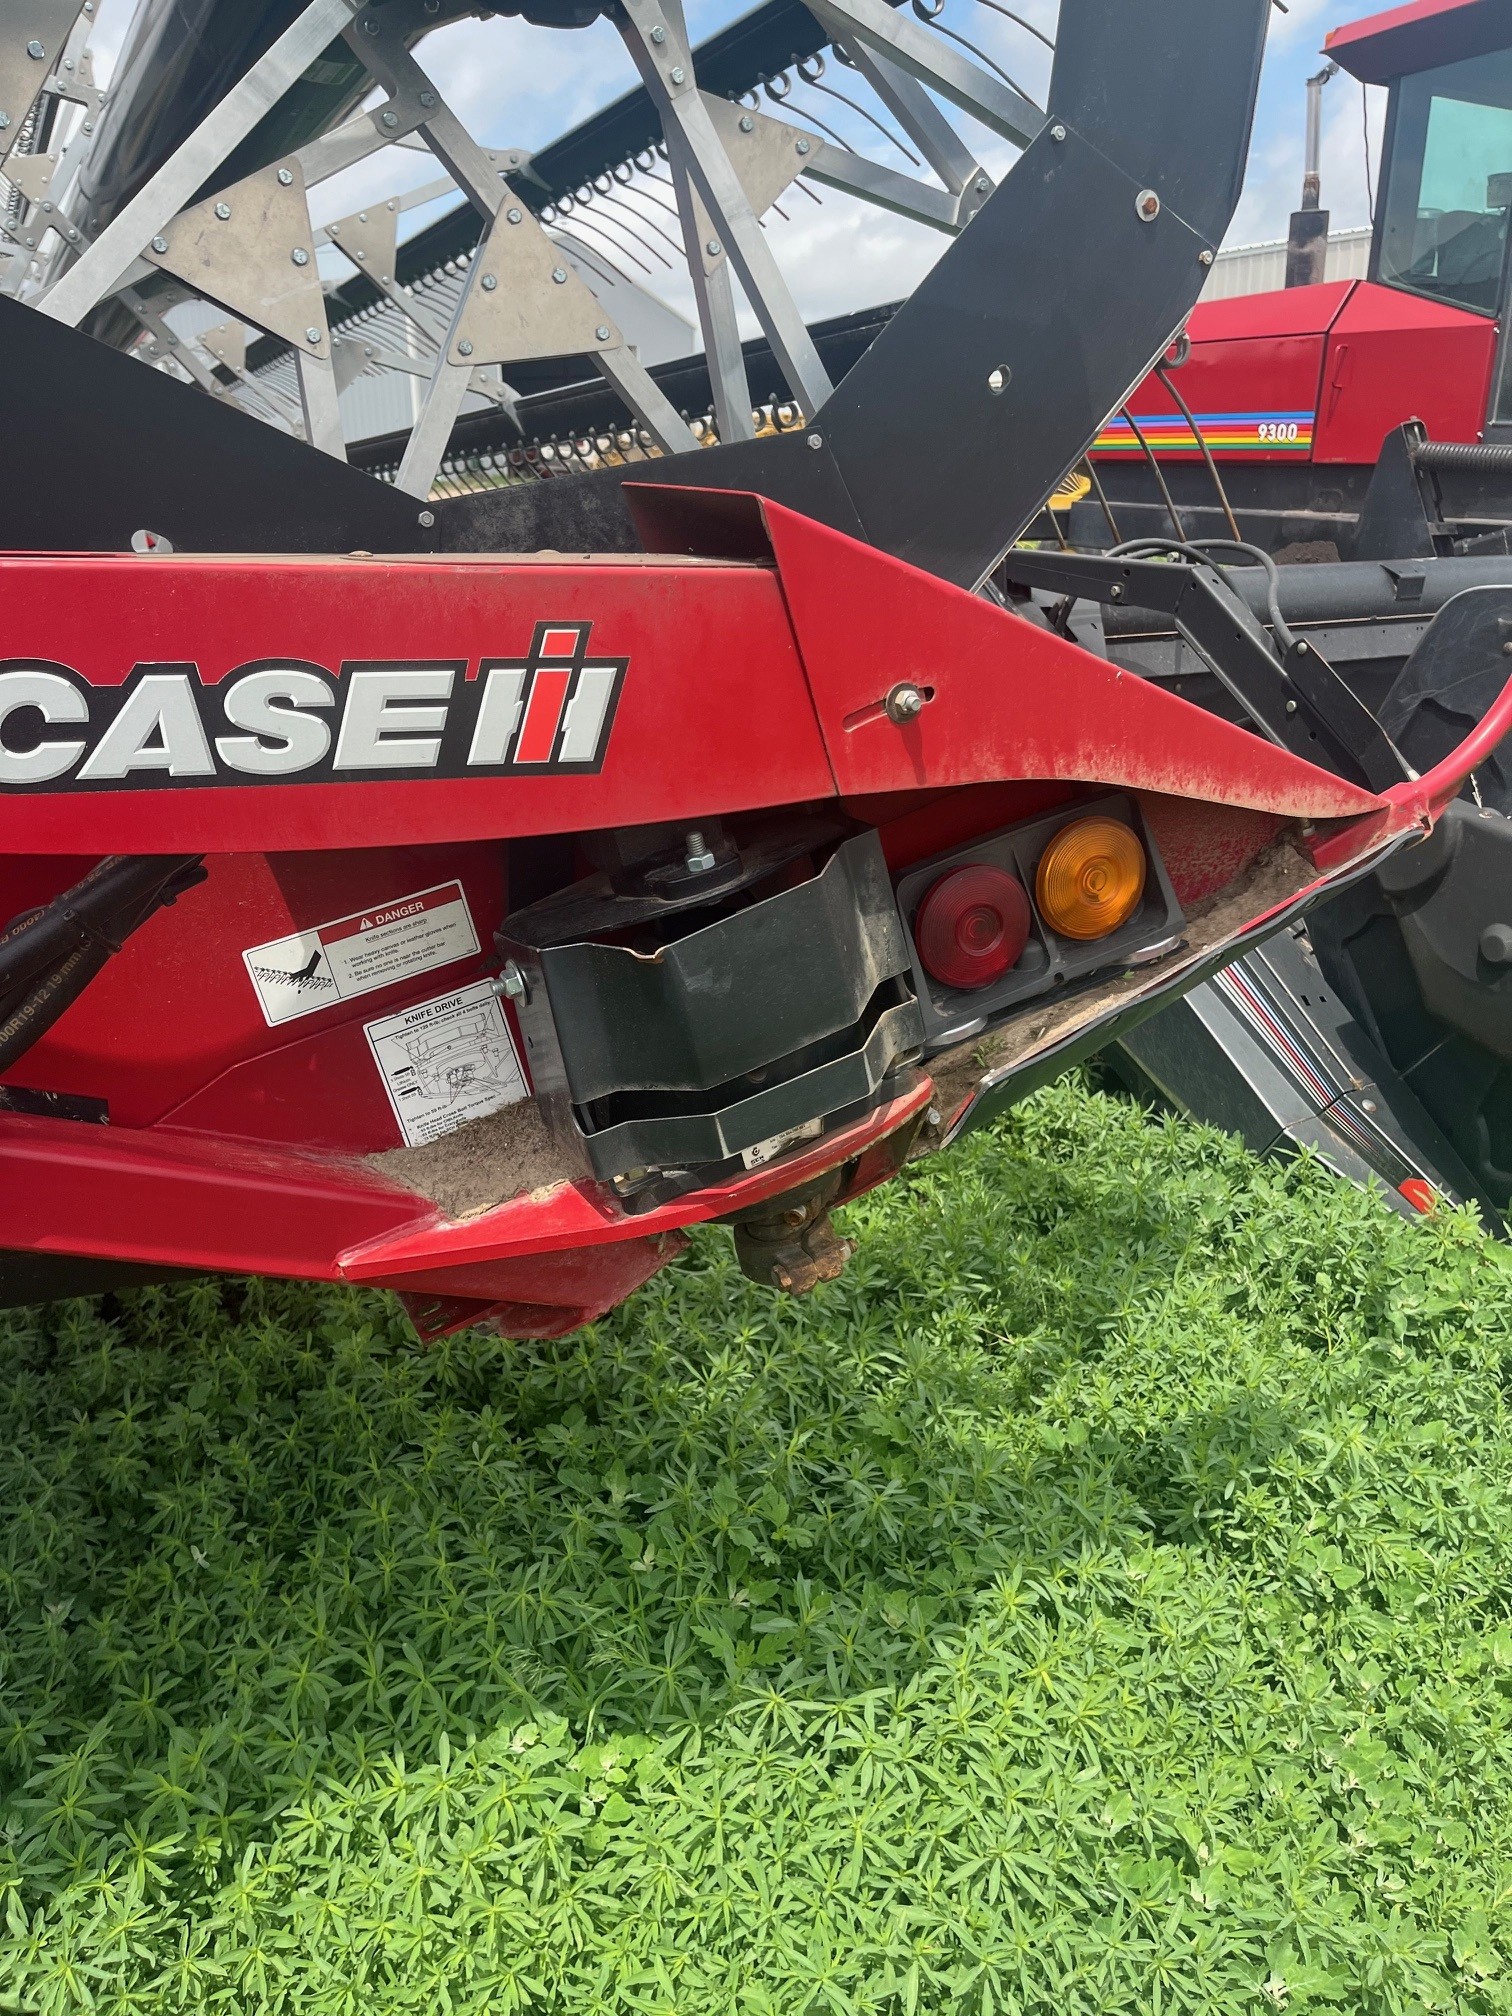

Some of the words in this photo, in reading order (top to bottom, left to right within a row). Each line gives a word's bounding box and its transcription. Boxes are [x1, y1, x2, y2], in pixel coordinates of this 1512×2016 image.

[1258, 423, 1298, 442] 9300
[0, 670, 455, 783] CASE
[375, 901, 424, 925] DANGER
[349, 953, 364, 962] Wear
[365, 950, 380, 959] heavy
[381, 943, 400, 952] canvas
[407, 934, 424, 943] leather
[425, 927, 442, 938] gloves
[443, 923, 457, 931] when
[365, 934, 379, 943] Knife
[380, 927, 403, 938] sections
[352, 958, 373, 968] working
[374, 954, 384, 962] with
[372, 966, 396, 977] removing
[403, 956, 423, 966] rotating
[400, 954, 411, 962] near
[0, 988, 51, 1046] 00R19-12
[49, 974, 63, 989] 19
[60, 951, 82, 977] mm
[405, 1008, 433, 1025] KNIFE
[435, 997, 464, 1014] DRIVE
[395, 1031, 414, 1040] Tighten
[407, 1114, 425, 1124] Tighten
[443, 1110, 457, 1119] Cross
[468, 1100, 484, 1109] Torque
